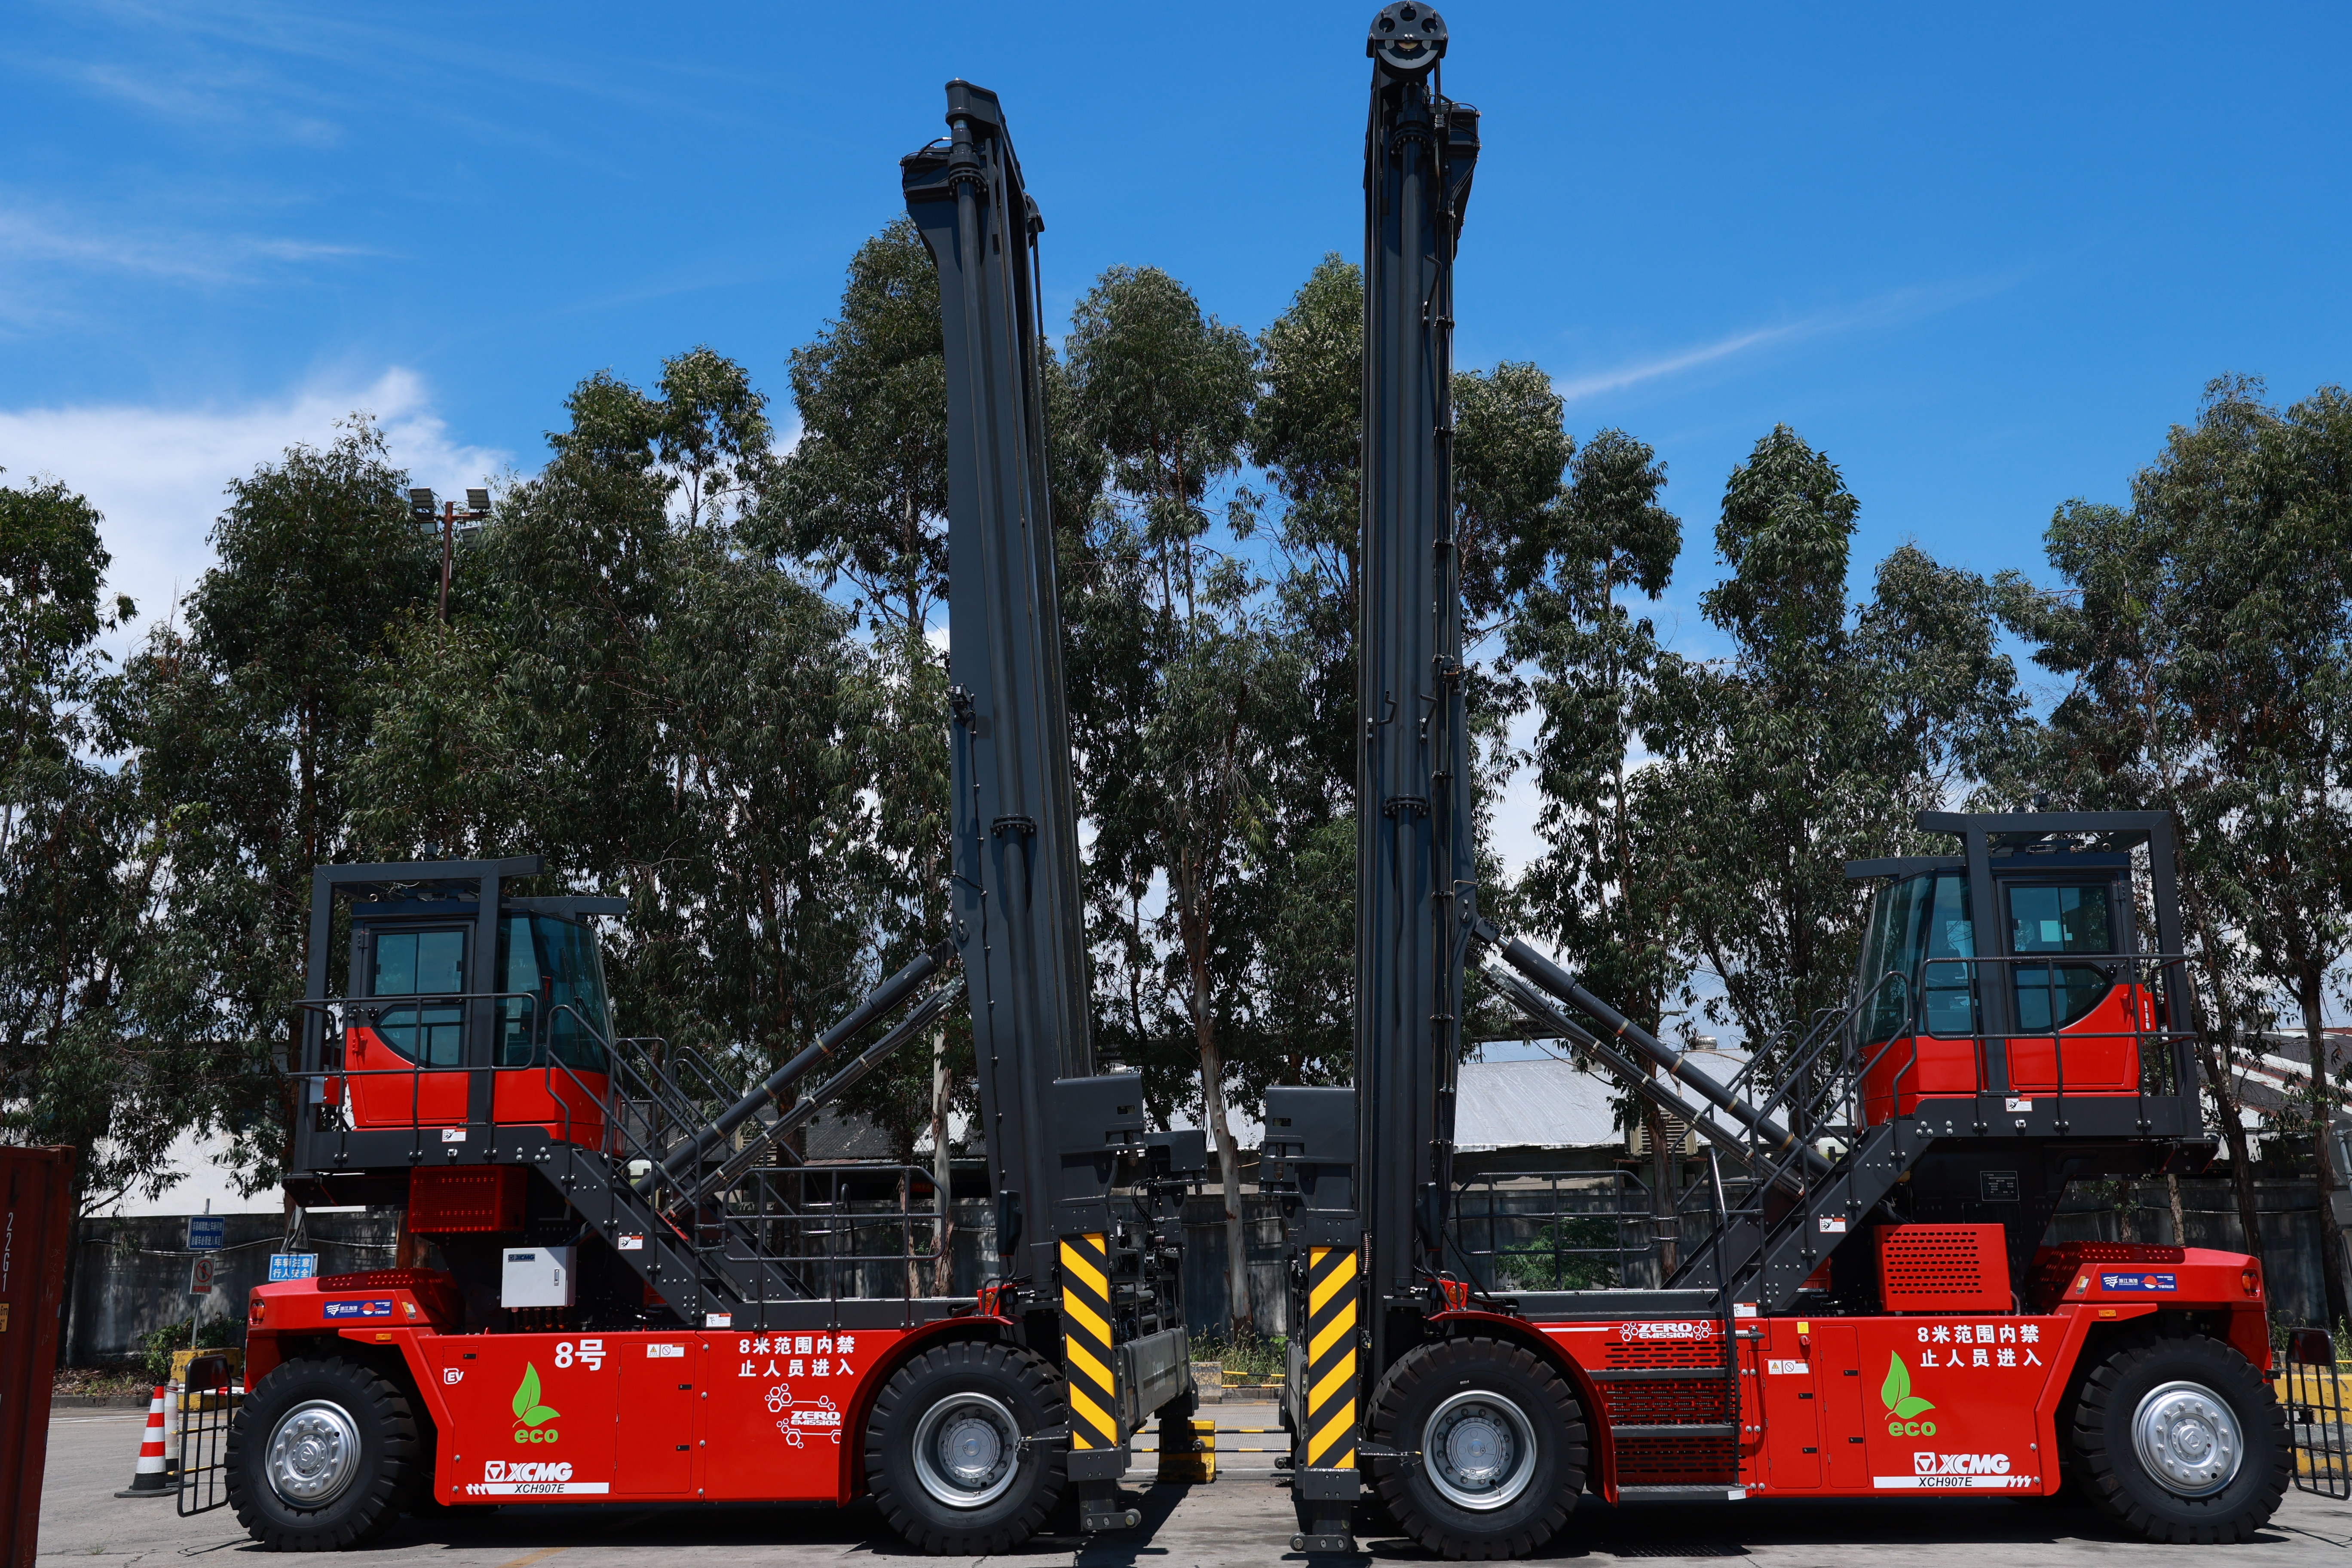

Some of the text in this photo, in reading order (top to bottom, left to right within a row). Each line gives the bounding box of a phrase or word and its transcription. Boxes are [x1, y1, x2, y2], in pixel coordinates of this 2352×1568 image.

[3, 1212, 13, 1292] 22G1
[274, 1258, 310, 1267] 车辆注意
[273, 1268, 309, 1278] 行人安全
[1638, 1323, 1692, 1332] ZERO
[1917, 1324, 2039, 1344] 8米范围内禁
[739, 1335, 855, 1355] 8米范围内禁
[554, 1339, 606, 1371] 8号
[1920, 1348, 2042, 1367] 止人员进入
[738, 1358, 854, 1377] 止人员进入
[447, 1371, 464, 1381] EV
[791, 1411, 841, 1420] ZERO
[514, 1429, 558, 1443] eco
[1889, 1421, 1936, 1436] eco
[1936, 1454, 2010, 1474] XCMG
[504, 1462, 573, 1482] XCMG
[514, 1484, 565, 1493] XCH907E
[1919, 1477, 1972, 1487] XCH907E
